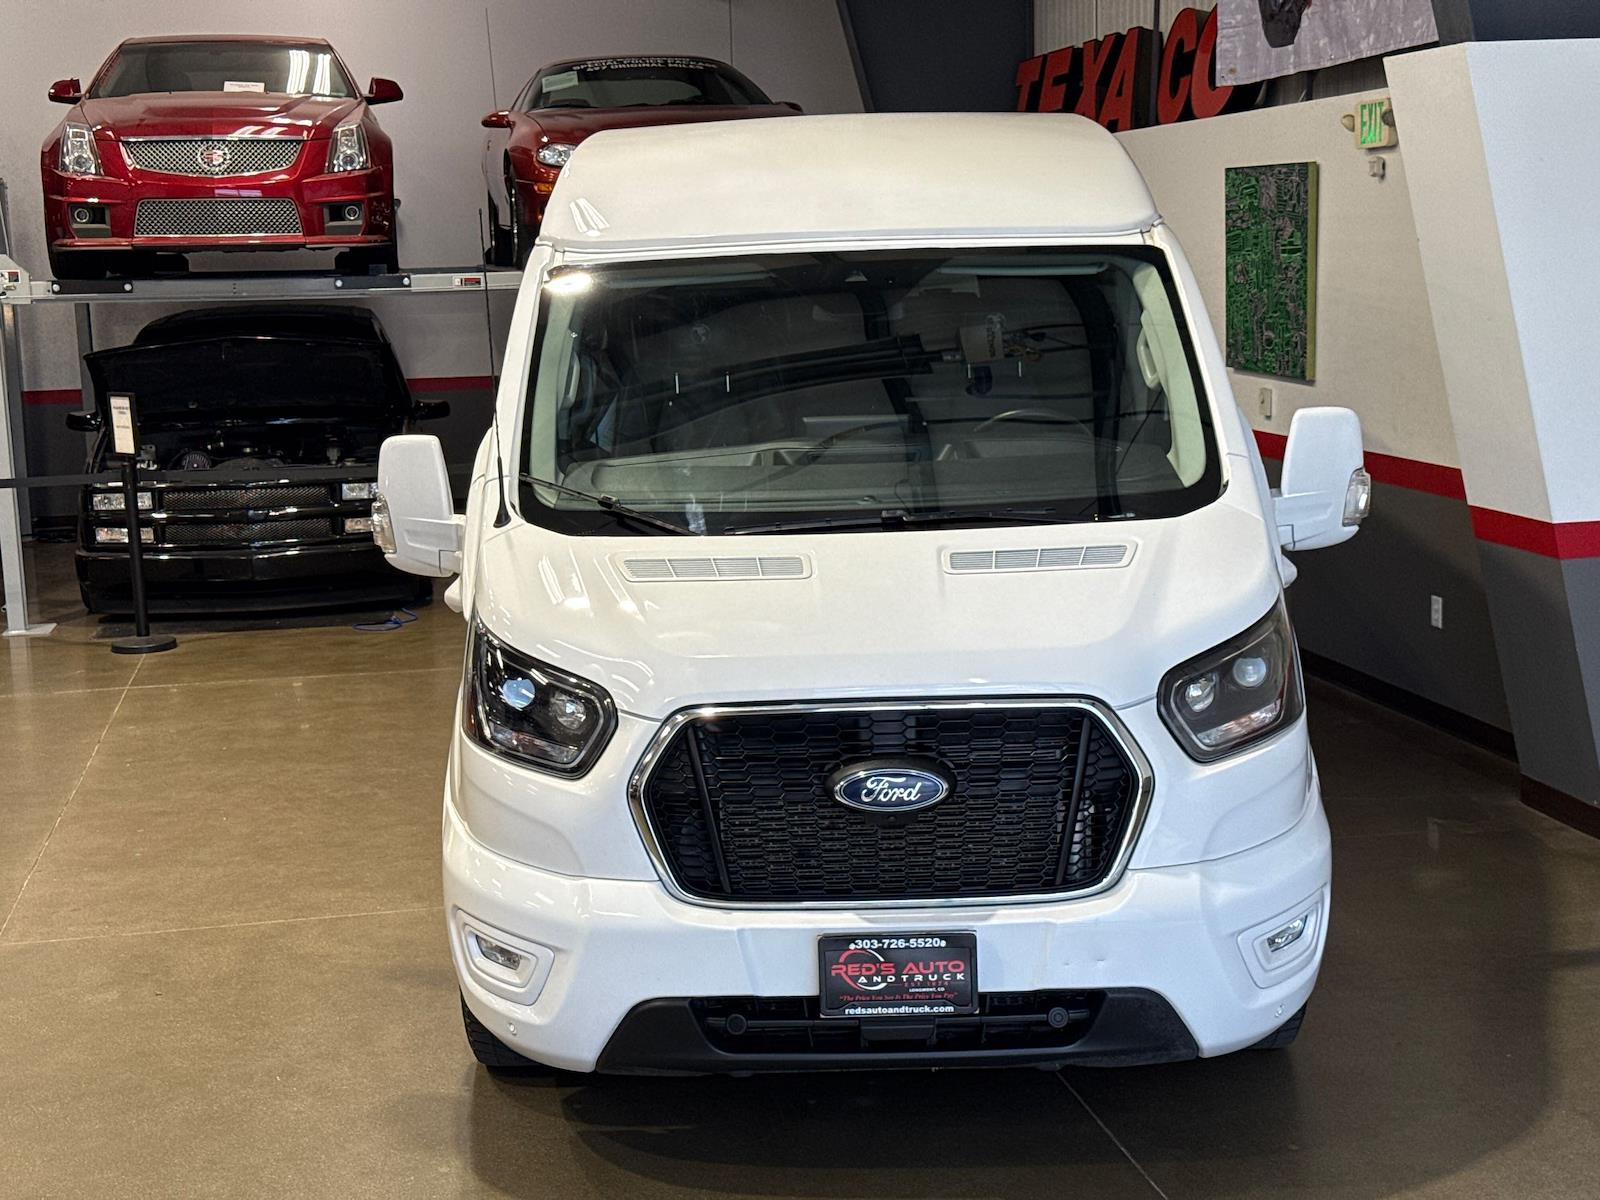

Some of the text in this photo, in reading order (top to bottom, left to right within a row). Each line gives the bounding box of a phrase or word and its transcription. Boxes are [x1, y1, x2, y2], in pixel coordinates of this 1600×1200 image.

[1360, 101, 1385, 145] EXIT
[861, 776, 922, 802] Ford
[854, 938, 941, 949] 303-726-5520
[831, 960, 965, 977] RED'S AUTO
[858, 972, 965, 983] AND TRUCK
[845, 1004, 955, 1015] redsautoandtruck.com
